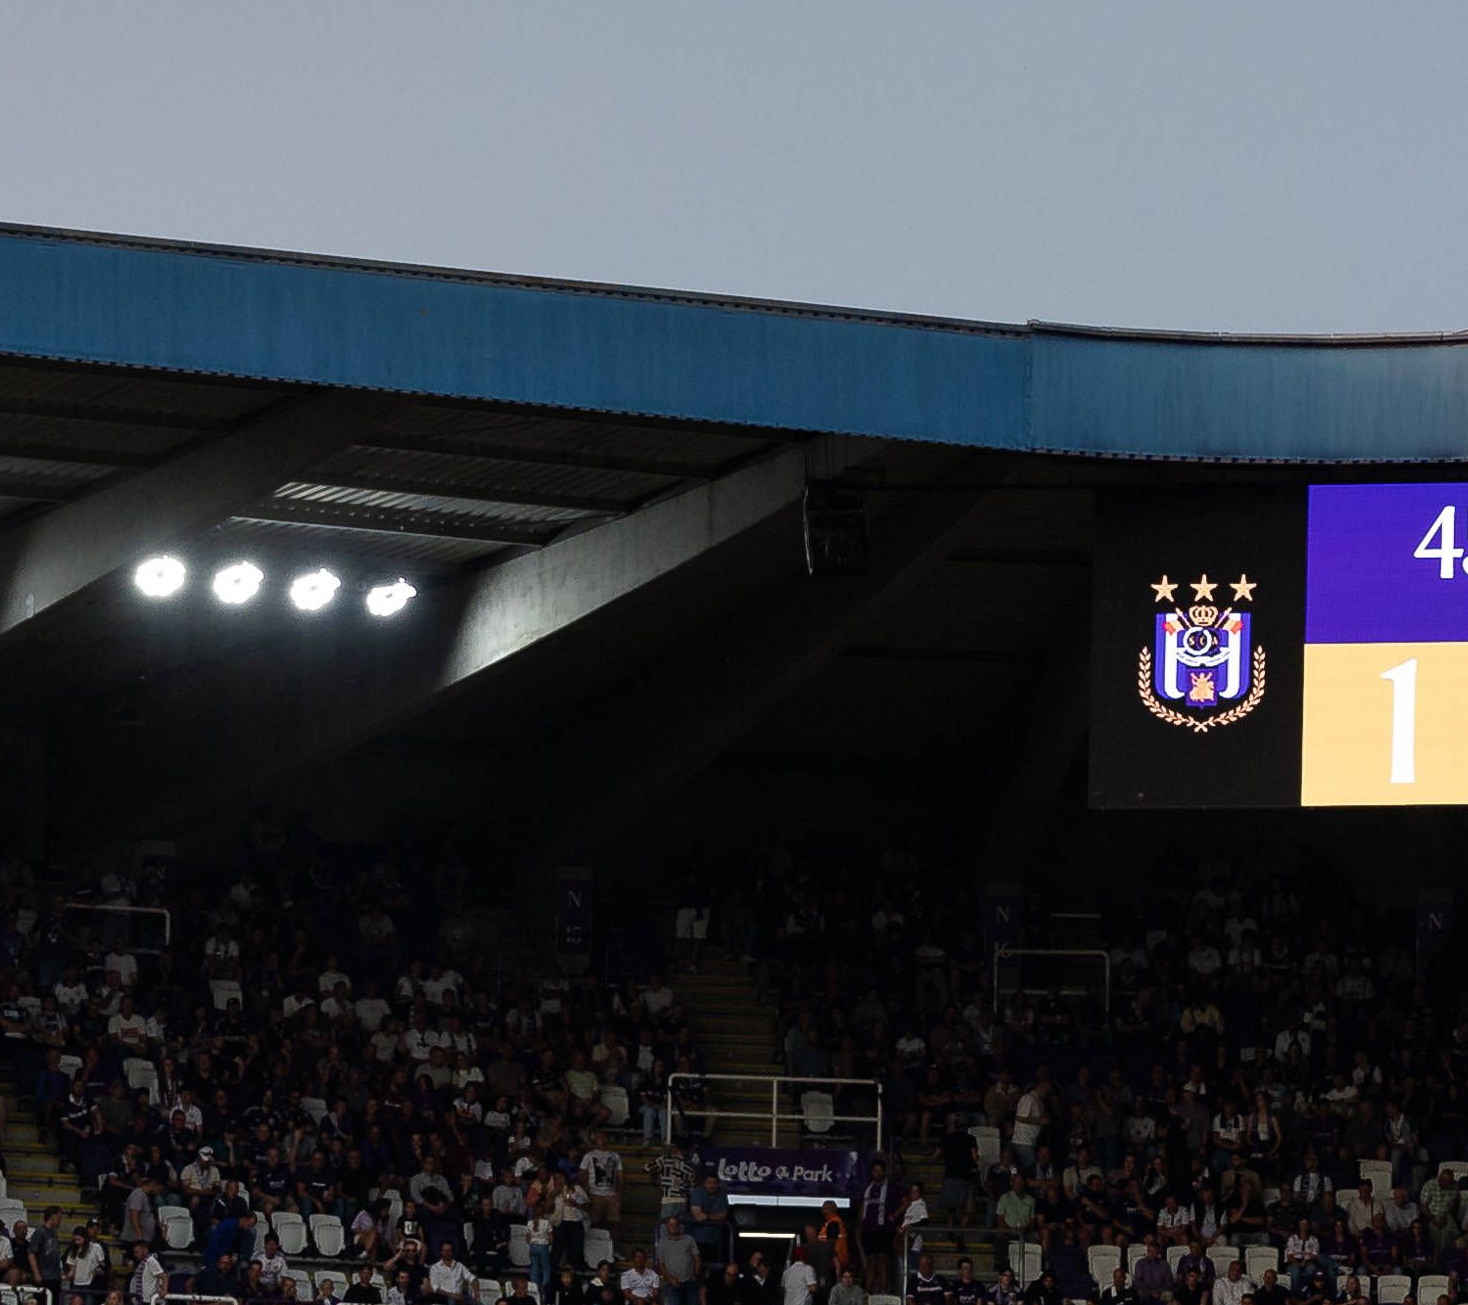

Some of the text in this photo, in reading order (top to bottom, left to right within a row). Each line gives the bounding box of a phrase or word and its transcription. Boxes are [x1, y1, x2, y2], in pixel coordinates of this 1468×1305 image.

[1380, 658, 1419, 784] 1
[568, 891, 581, 909] N
[995, 907, 1012, 923] N
